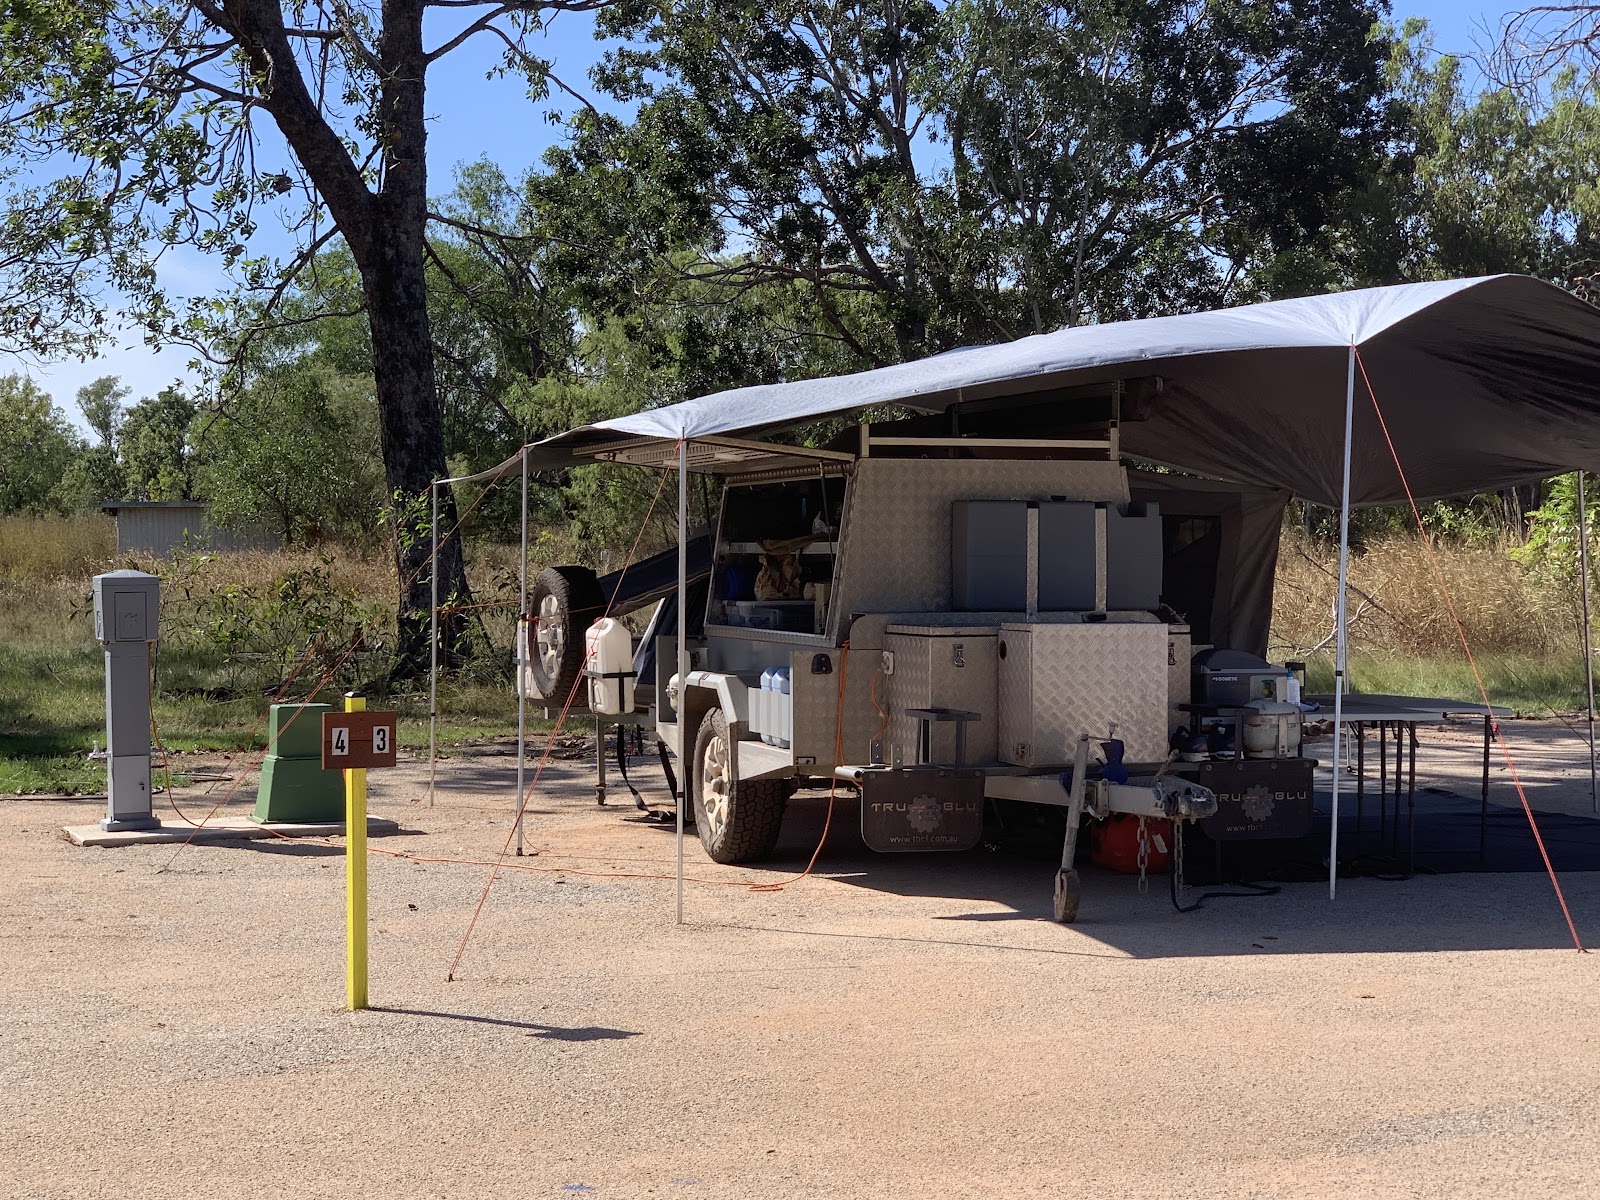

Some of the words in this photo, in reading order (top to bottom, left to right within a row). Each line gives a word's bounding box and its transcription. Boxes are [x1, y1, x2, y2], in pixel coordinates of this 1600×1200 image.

[335, 729, 346, 753] 4
[376, 728, 386, 752] 3
[1275, 791, 1307, 800] BLU
[871, 802, 906, 812] TRU
[943, 802, 977, 811] BLU
